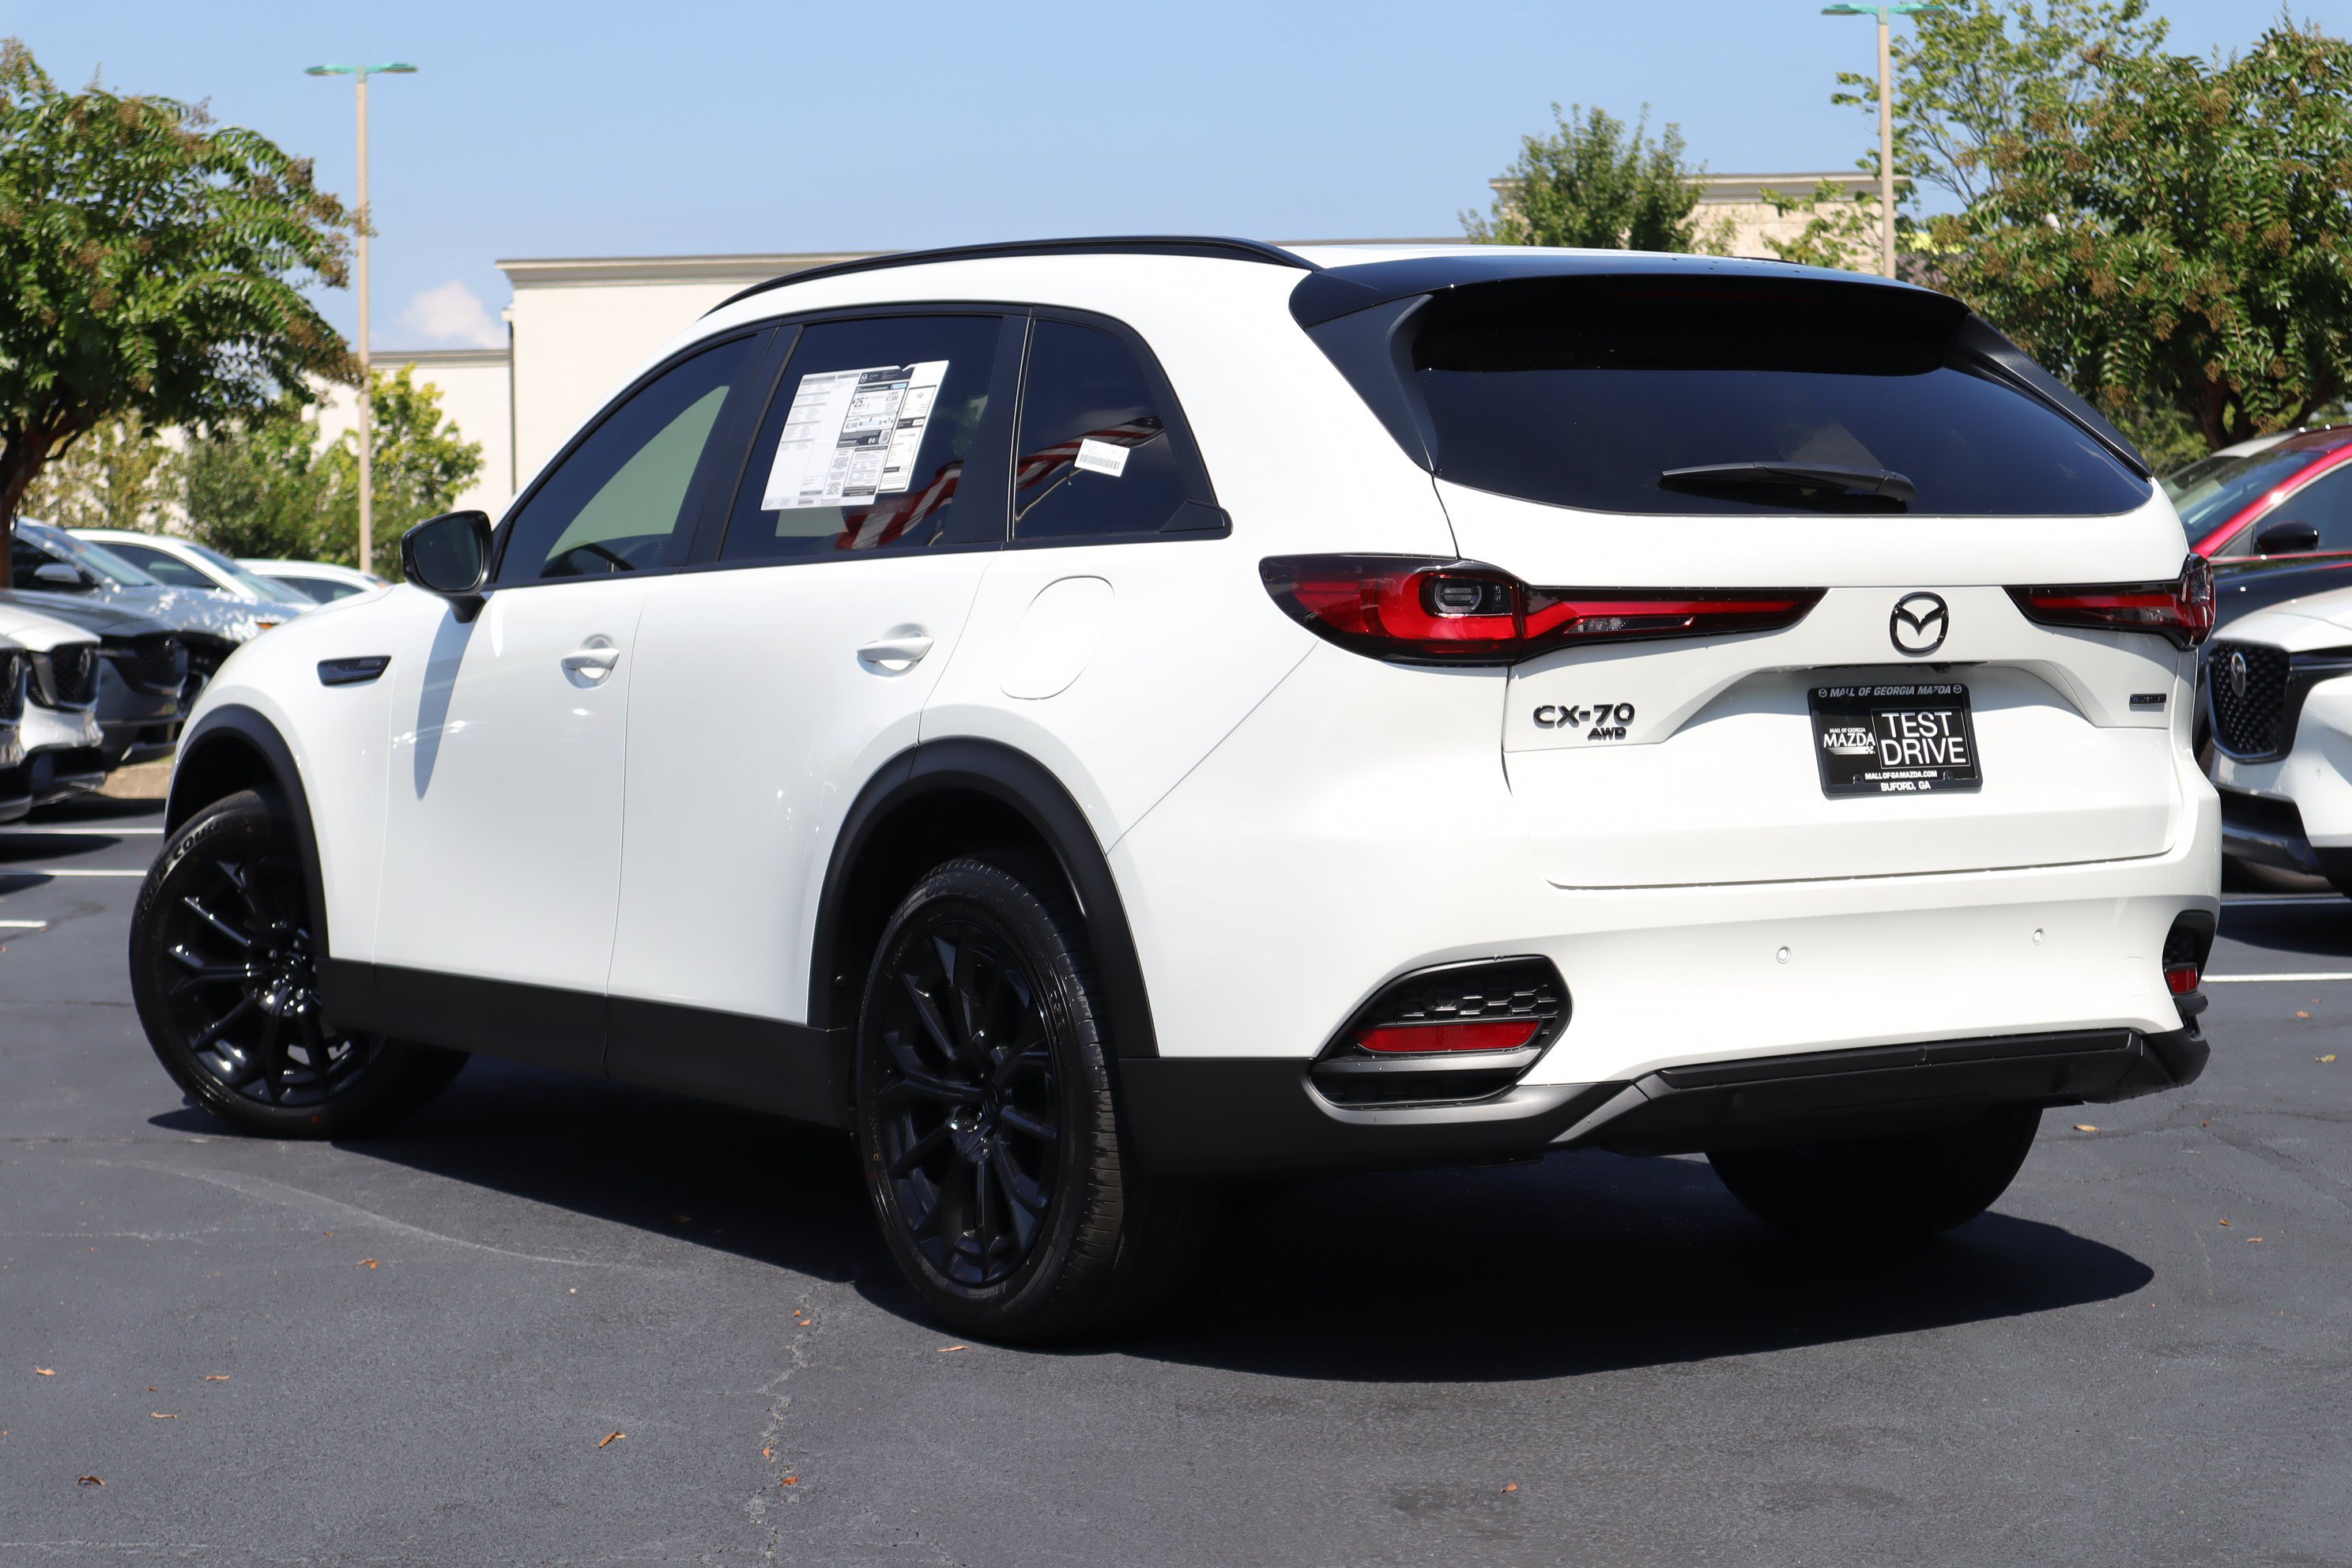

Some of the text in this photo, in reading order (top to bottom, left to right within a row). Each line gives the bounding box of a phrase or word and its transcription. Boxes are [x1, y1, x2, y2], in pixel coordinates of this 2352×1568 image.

[854, 397, 864, 408] 25
[1830, 685, 1951, 697] MALL OF GEORGIA MAZDA
[1533, 703, 1635, 729] CX-70
[1882, 711, 1952, 738] TEST
[1587, 727, 1626, 741] AWD
[1823, 732, 1875, 748] MAZDA
[1881, 737, 1966, 765] DRIVE
[1865, 771, 1938, 780] MALLOFGAMAZDA.COM
[1881, 781, 1932, 792] BUFORD, GA
